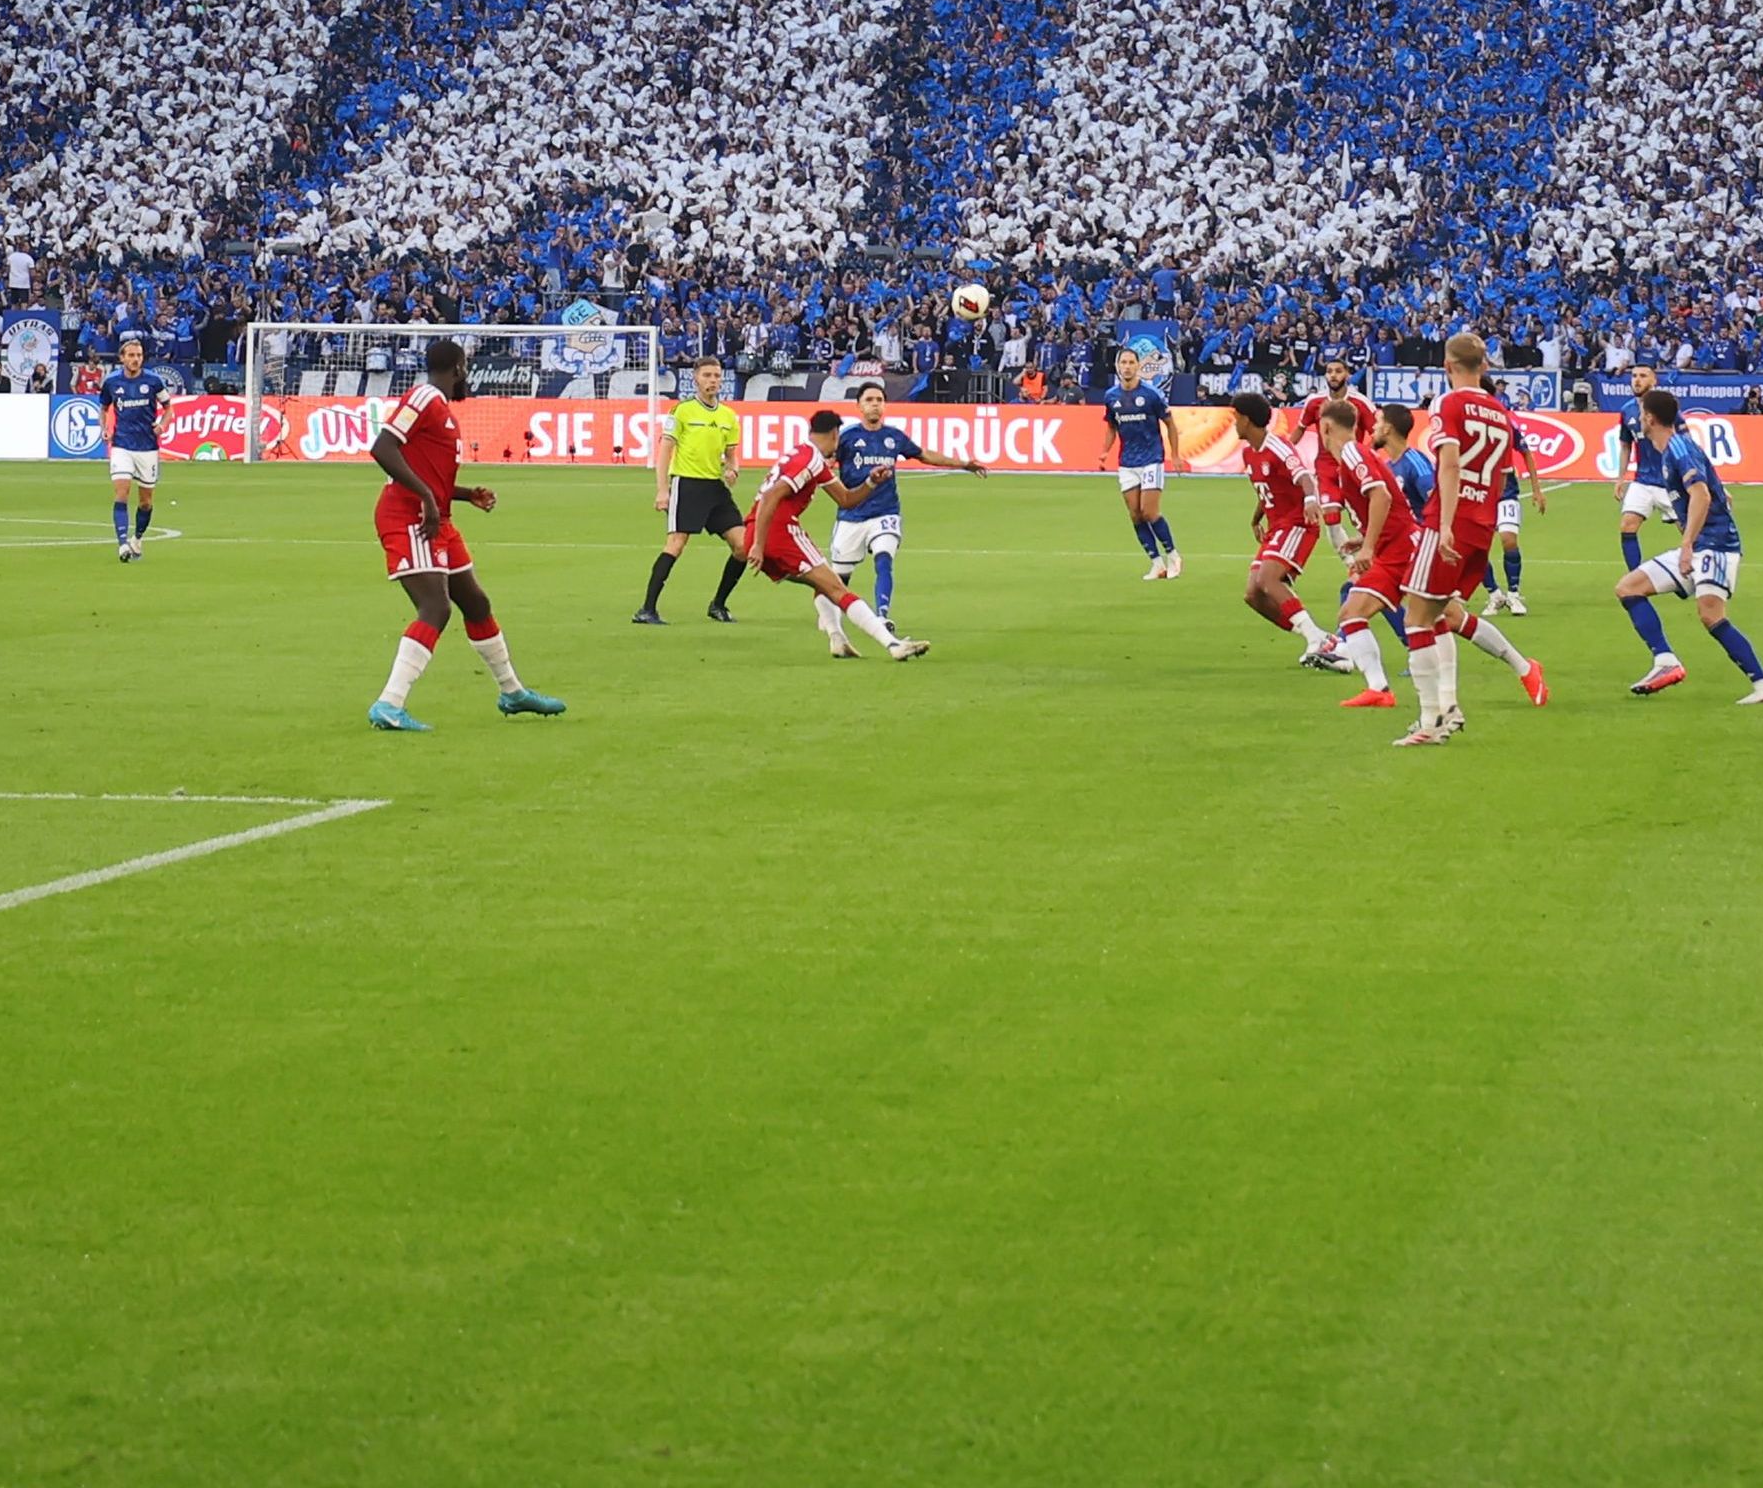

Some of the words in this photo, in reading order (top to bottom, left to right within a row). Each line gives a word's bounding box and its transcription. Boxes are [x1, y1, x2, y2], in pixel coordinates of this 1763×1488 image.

[1690, 383, 1742, 402] Knappen
[1465, 403, 1478, 417] FC
[161, 405, 269, 445] gutfrie
[529, 412, 593, 458] SIE
[1459, 420, 1510, 488] 27
[1504, 505, 1518, 521] 13
[1702, 554, 1711, 574] 8
